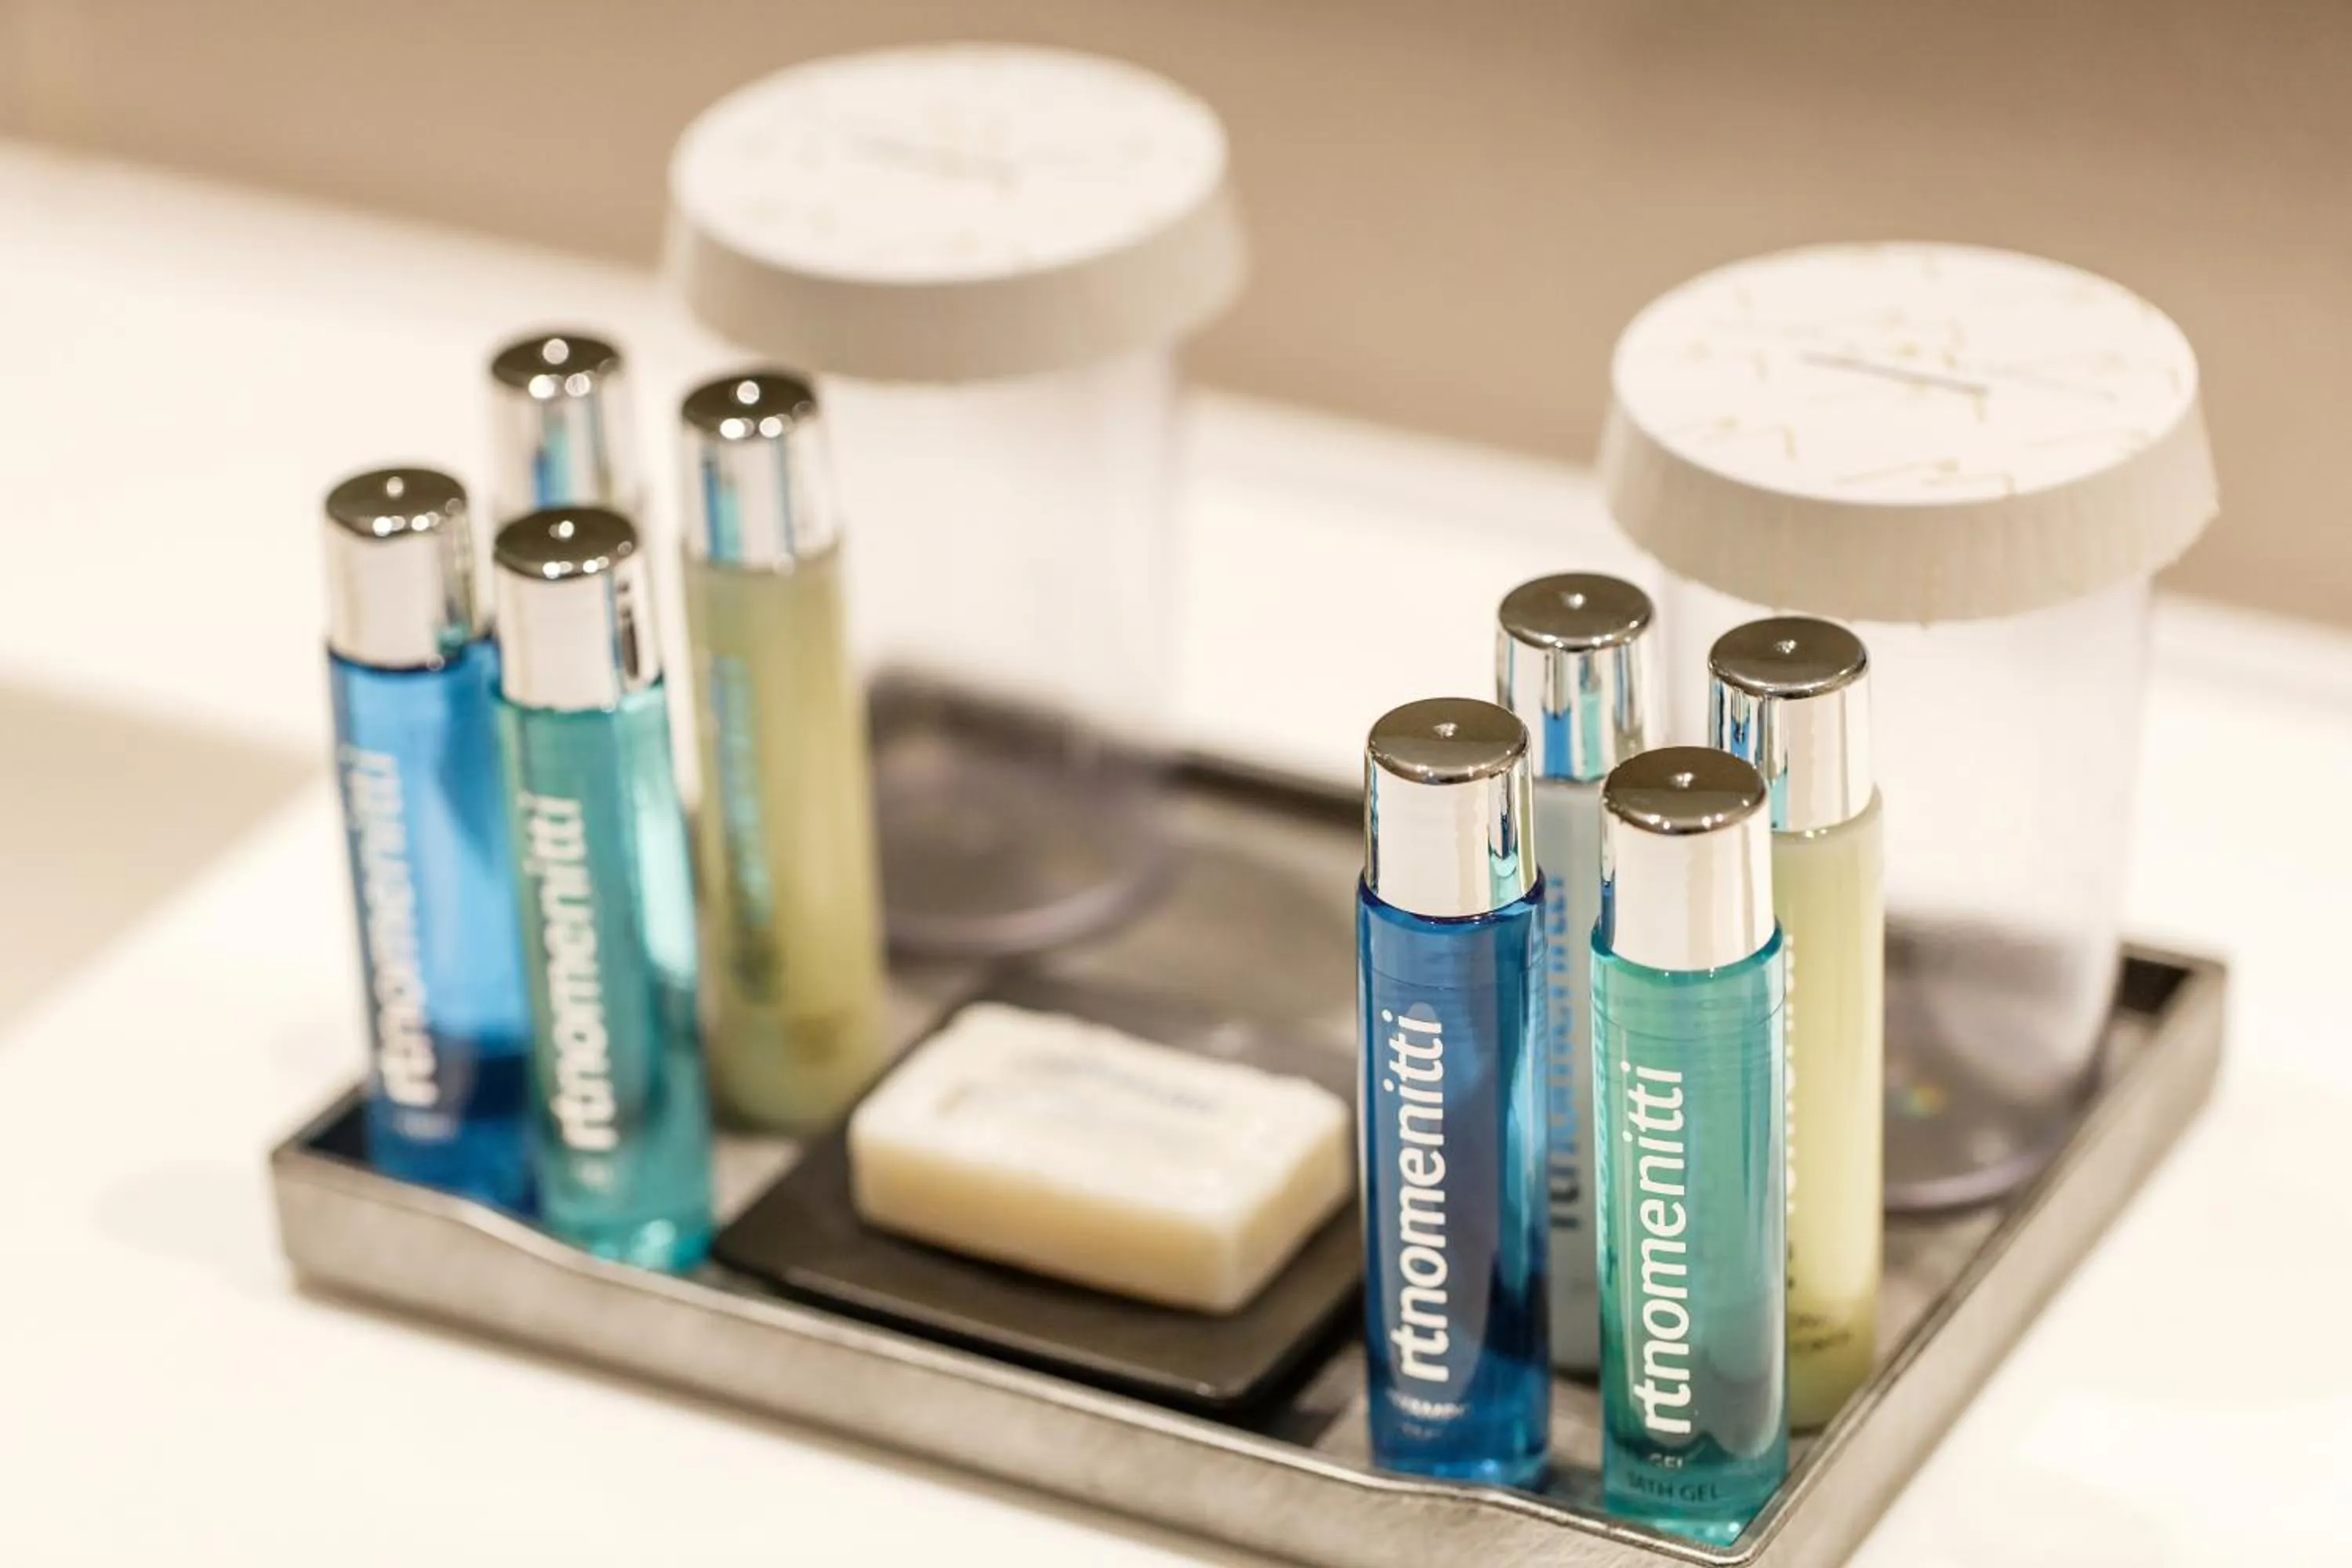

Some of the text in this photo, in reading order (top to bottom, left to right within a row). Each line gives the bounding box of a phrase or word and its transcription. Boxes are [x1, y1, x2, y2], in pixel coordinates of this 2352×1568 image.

[1381, 1008, 1450, 1383] rtnomenitti
[1620, 1060, 1692, 1434] rtnomenitti
[1679, 1483, 1722, 1502] GEL
